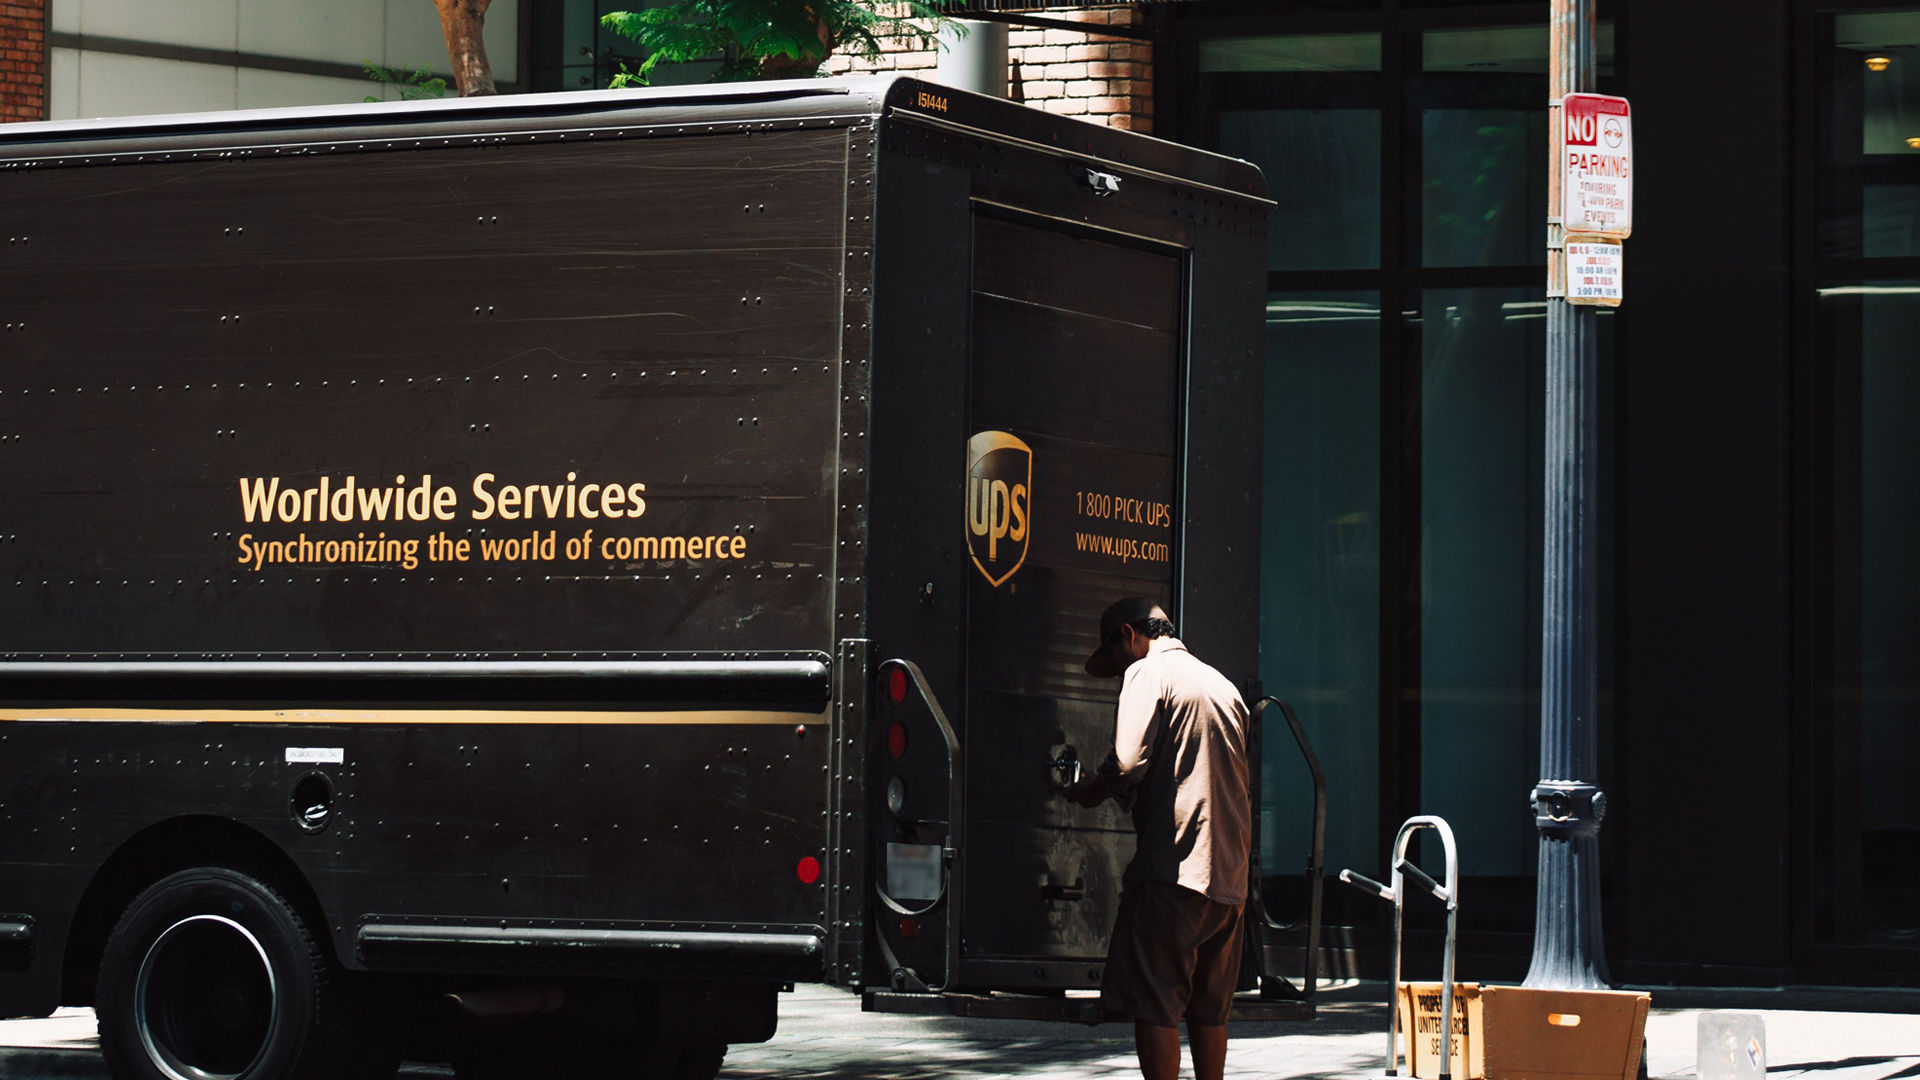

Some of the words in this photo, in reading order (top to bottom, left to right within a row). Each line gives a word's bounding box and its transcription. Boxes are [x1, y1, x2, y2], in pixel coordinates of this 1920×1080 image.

[918, 91, 948, 113] 151444
[1567, 114, 1596, 143] NO
[1569, 153, 1628, 179] PARKING
[1584, 210, 1616, 224] EVENTS
[239, 474, 458, 524] Worldwide
[471, 472, 647, 521] Services
[1076, 491, 1083, 515] 1
[1086, 492, 1111, 519] 800
[1114, 496, 1144, 524] PICK
[1146, 501, 1171, 528] UPS
[969, 475, 1027, 562] ups
[237, 532, 419, 571] Synchronizing
[427, 531, 471, 562] the
[480, 530, 556, 562] world
[564, 529, 594, 561] of
[600, 532, 747, 560] commerce
[1076, 532, 1169, 563] www.ups.com
[1417, 994, 1442, 1013] PROPE
[1454, 995, 1465, 1014] OF
[1451, 1017, 1469, 1036] RCEL
[1431, 1038, 1458, 1057] SECE
